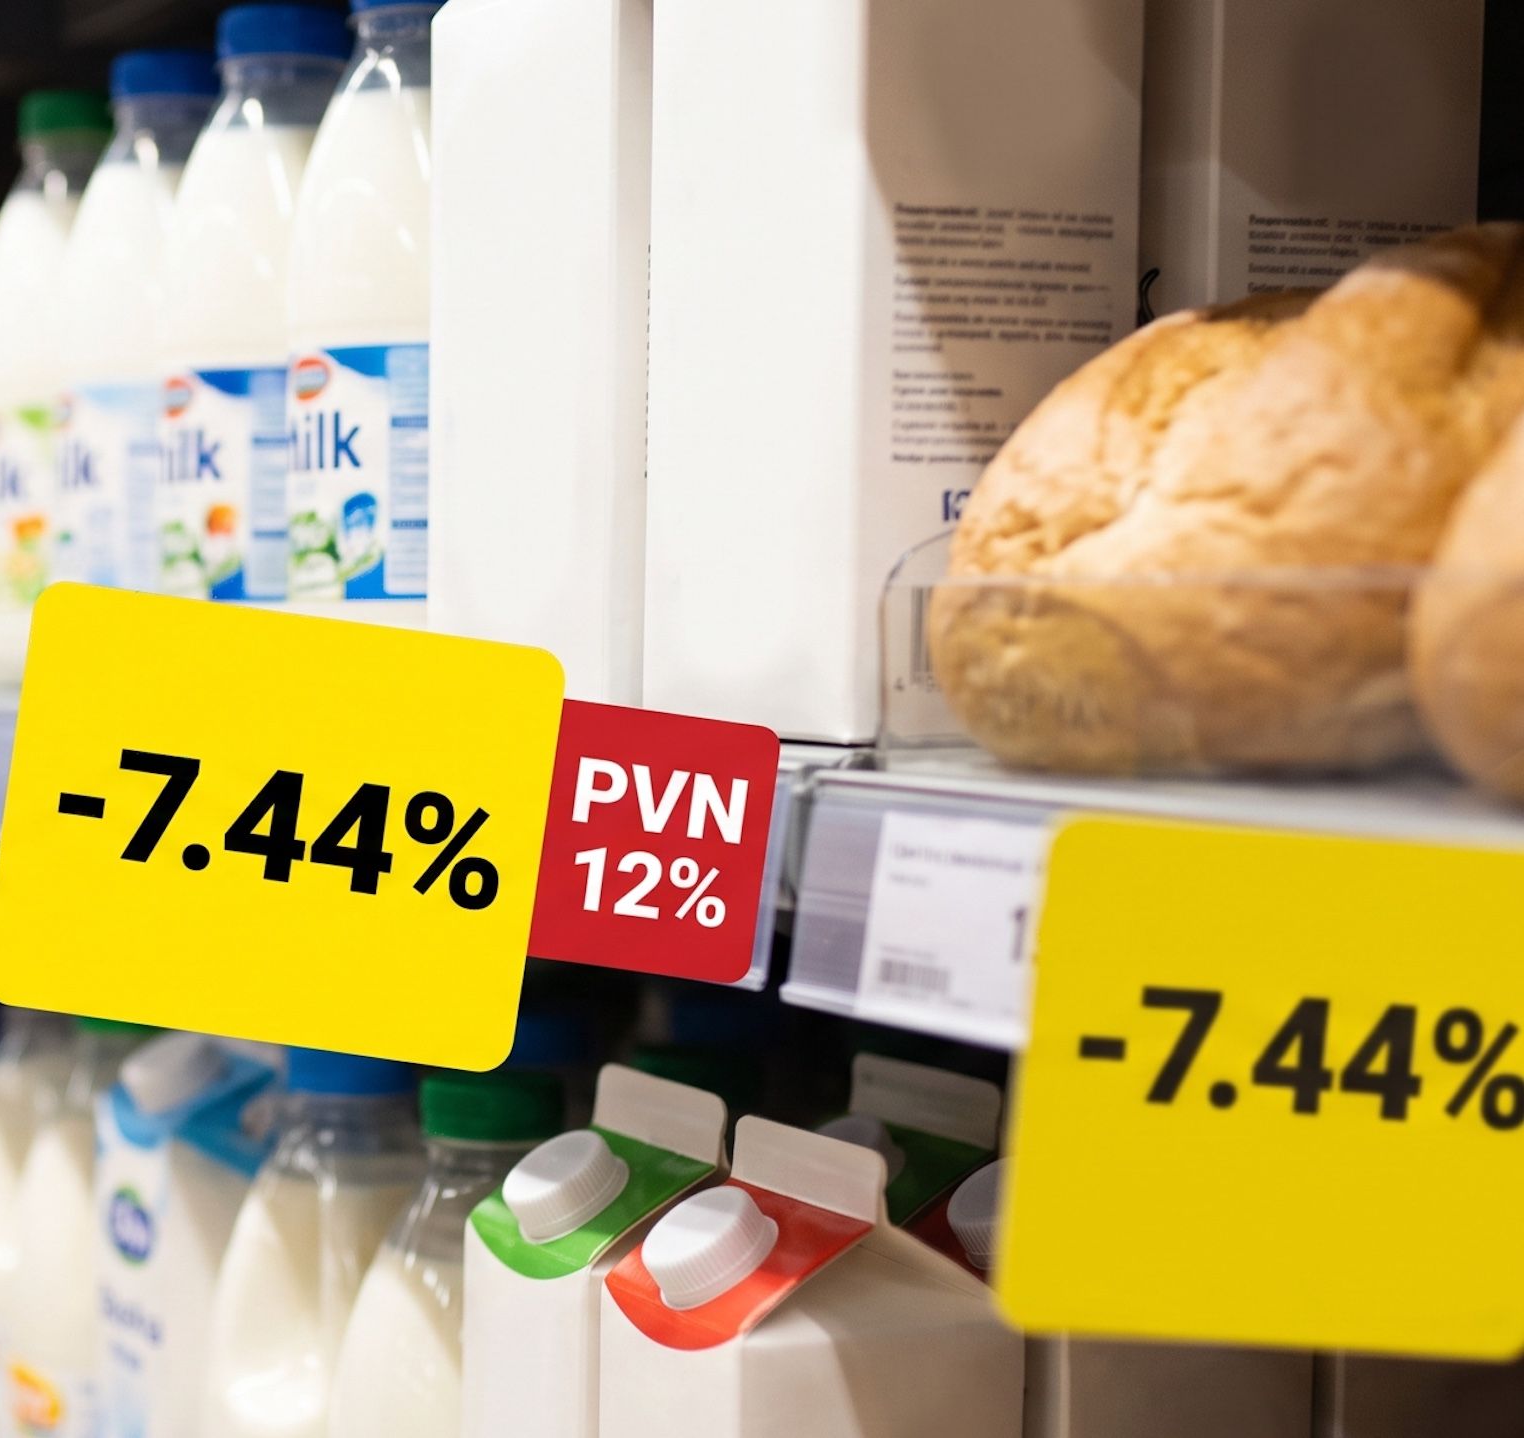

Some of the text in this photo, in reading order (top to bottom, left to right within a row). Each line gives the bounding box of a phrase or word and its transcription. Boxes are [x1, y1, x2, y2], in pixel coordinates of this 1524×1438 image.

[160, 428, 222, 482] ilk
[58, 748, 499, 910] -7.44%
[571, 756, 749, 844] PVN
[574, 847, 726, 928] 12%
[1078, 986, 1524, 1131] -7.44%
